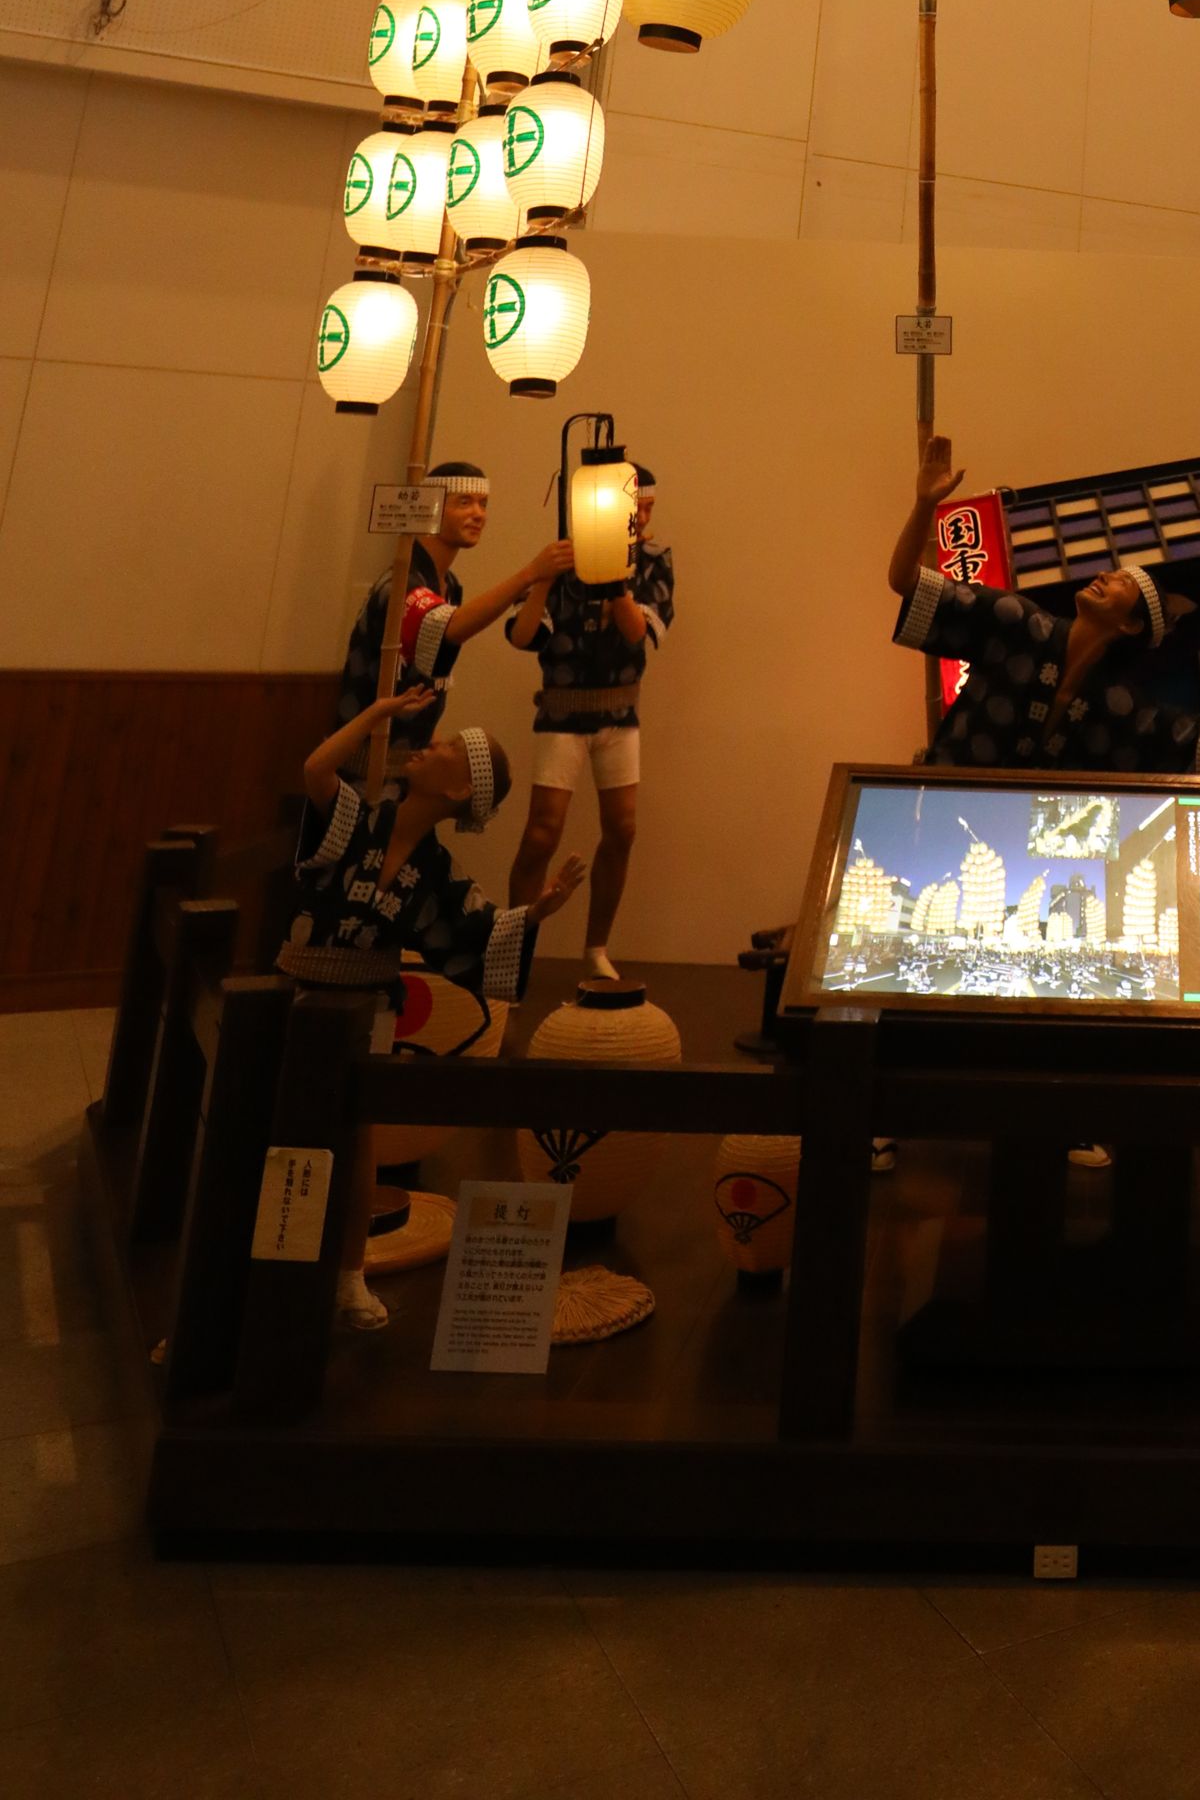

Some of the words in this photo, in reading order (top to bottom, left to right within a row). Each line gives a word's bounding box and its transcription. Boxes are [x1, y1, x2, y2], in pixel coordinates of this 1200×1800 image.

[337, 848, 385, 940] 秋田市
[493, 1203, 531, 1221] 提灯
